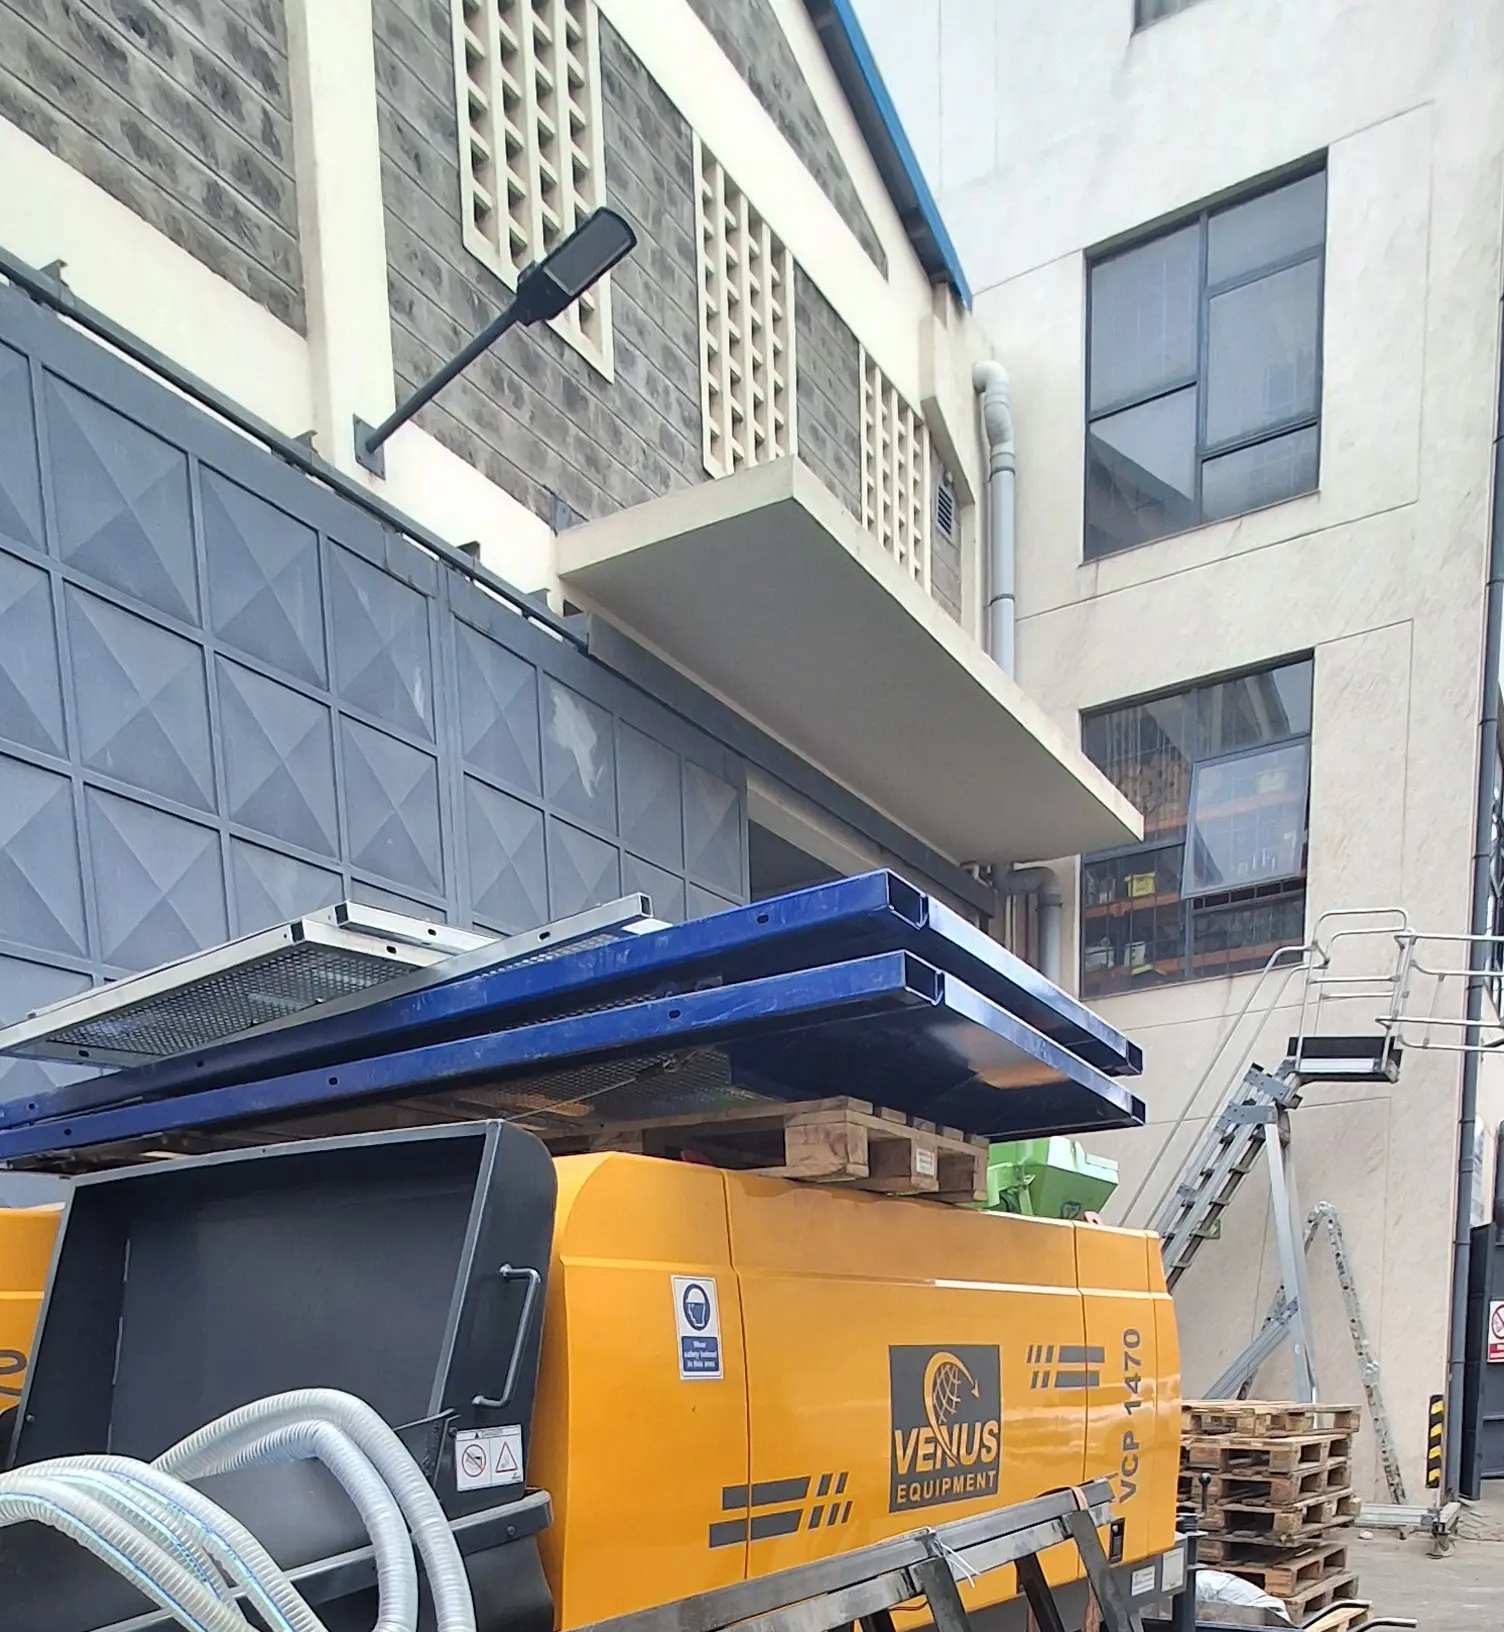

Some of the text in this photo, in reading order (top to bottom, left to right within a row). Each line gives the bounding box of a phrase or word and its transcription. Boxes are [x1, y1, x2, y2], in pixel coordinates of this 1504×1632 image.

[1119, 1328, 1142, 1505] VCP 1470
[894, 1420, 999, 1476] VENUS
[896, 1470, 997, 1504] EQUIPMENT
